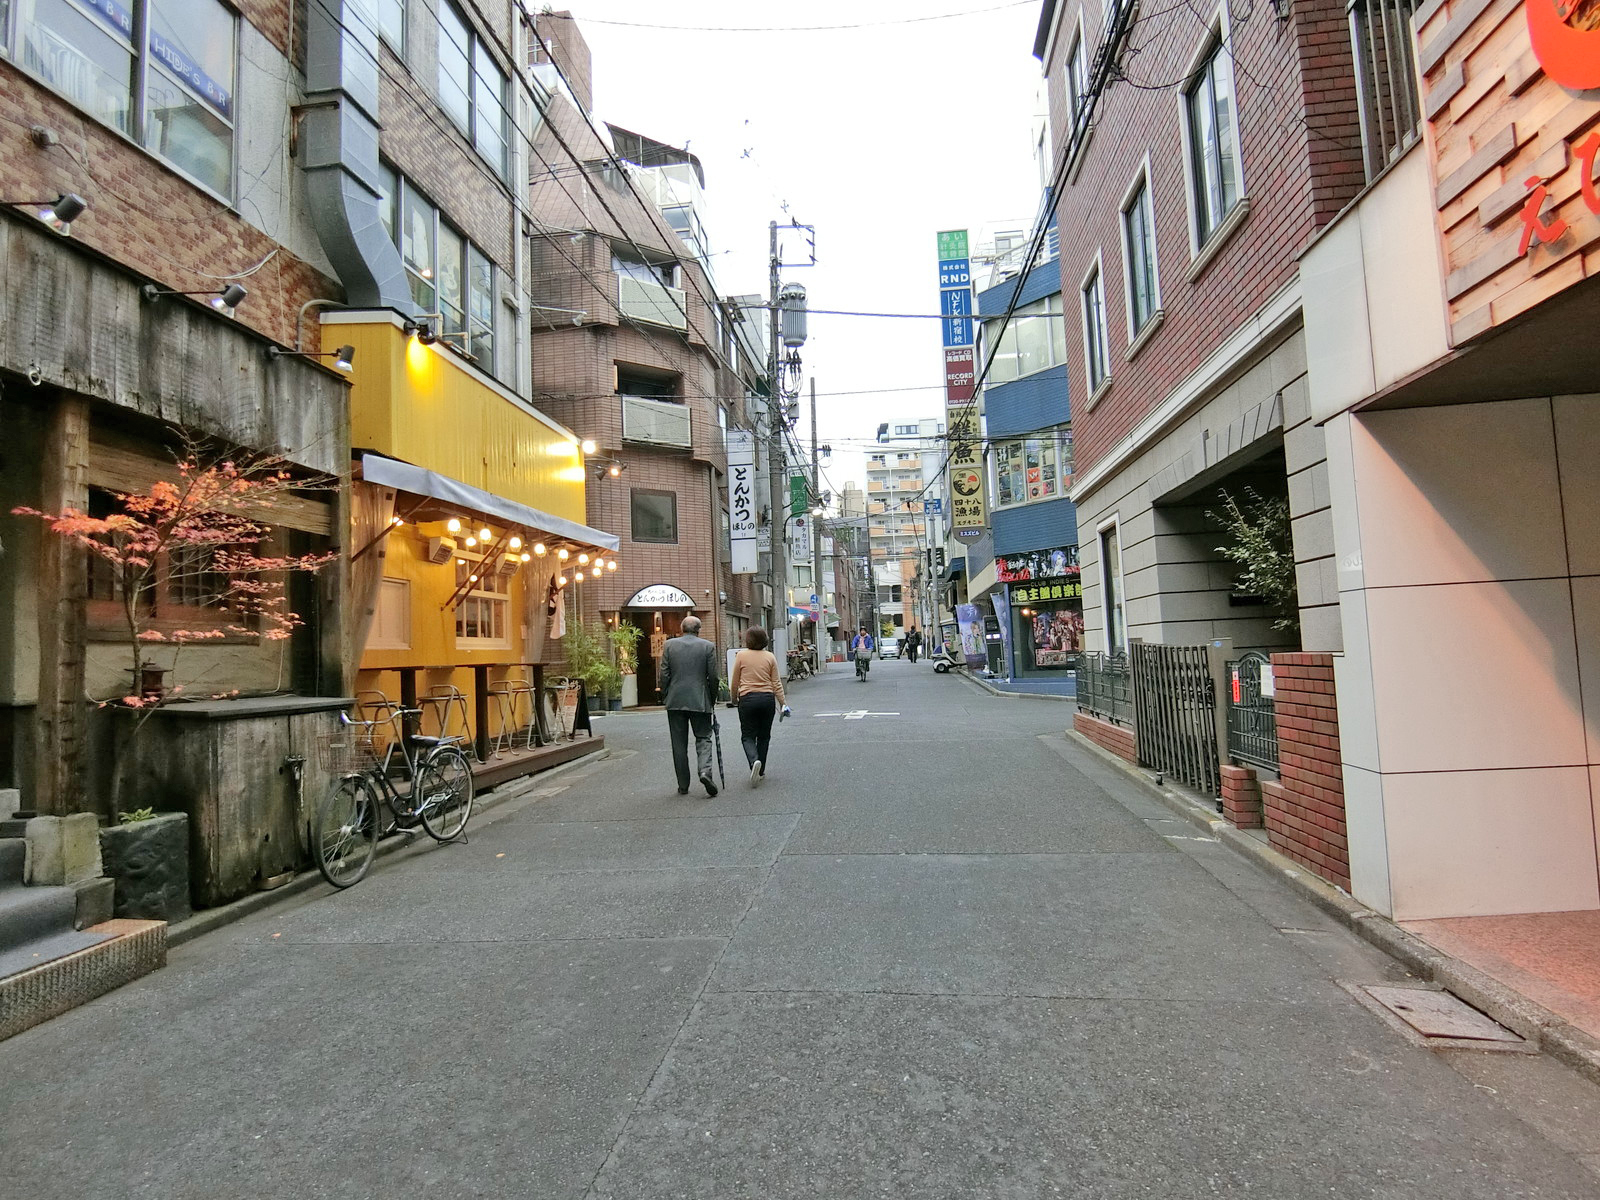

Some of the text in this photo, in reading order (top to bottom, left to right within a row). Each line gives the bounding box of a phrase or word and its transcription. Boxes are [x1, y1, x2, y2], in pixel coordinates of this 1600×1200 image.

[155, 37, 201, 85] HIDE'S
[941, 232, 963, 241] あい
[941, 273, 969, 284] RND
[946, 355, 972, 363] 高価買取
[734, 467, 750, 522] とんかつ
[954, 497, 982, 506] 四十八
[955, 506, 982, 517] 漁場
[732, 522, 755, 531] ほしの
